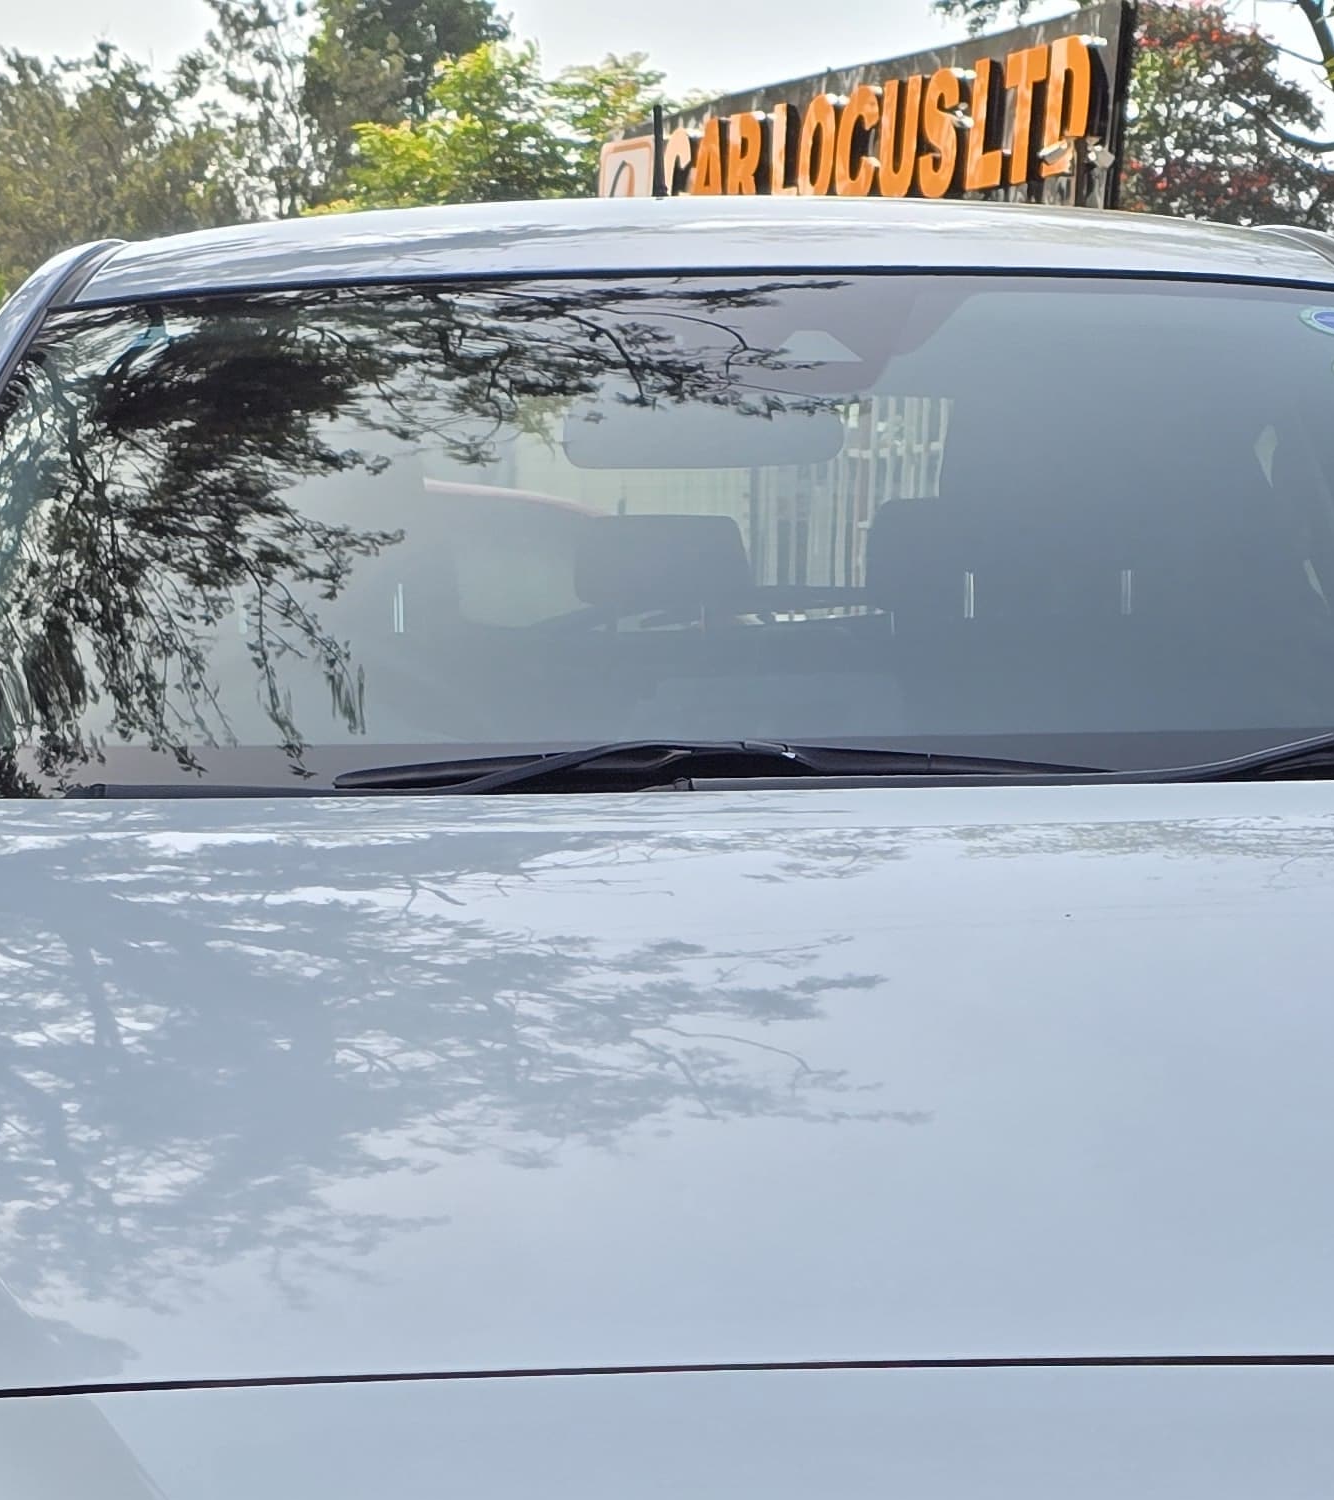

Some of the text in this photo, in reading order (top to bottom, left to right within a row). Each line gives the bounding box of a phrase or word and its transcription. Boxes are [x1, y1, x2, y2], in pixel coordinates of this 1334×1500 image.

[665, 34, 1091, 198] CAR LOCUS LTD
